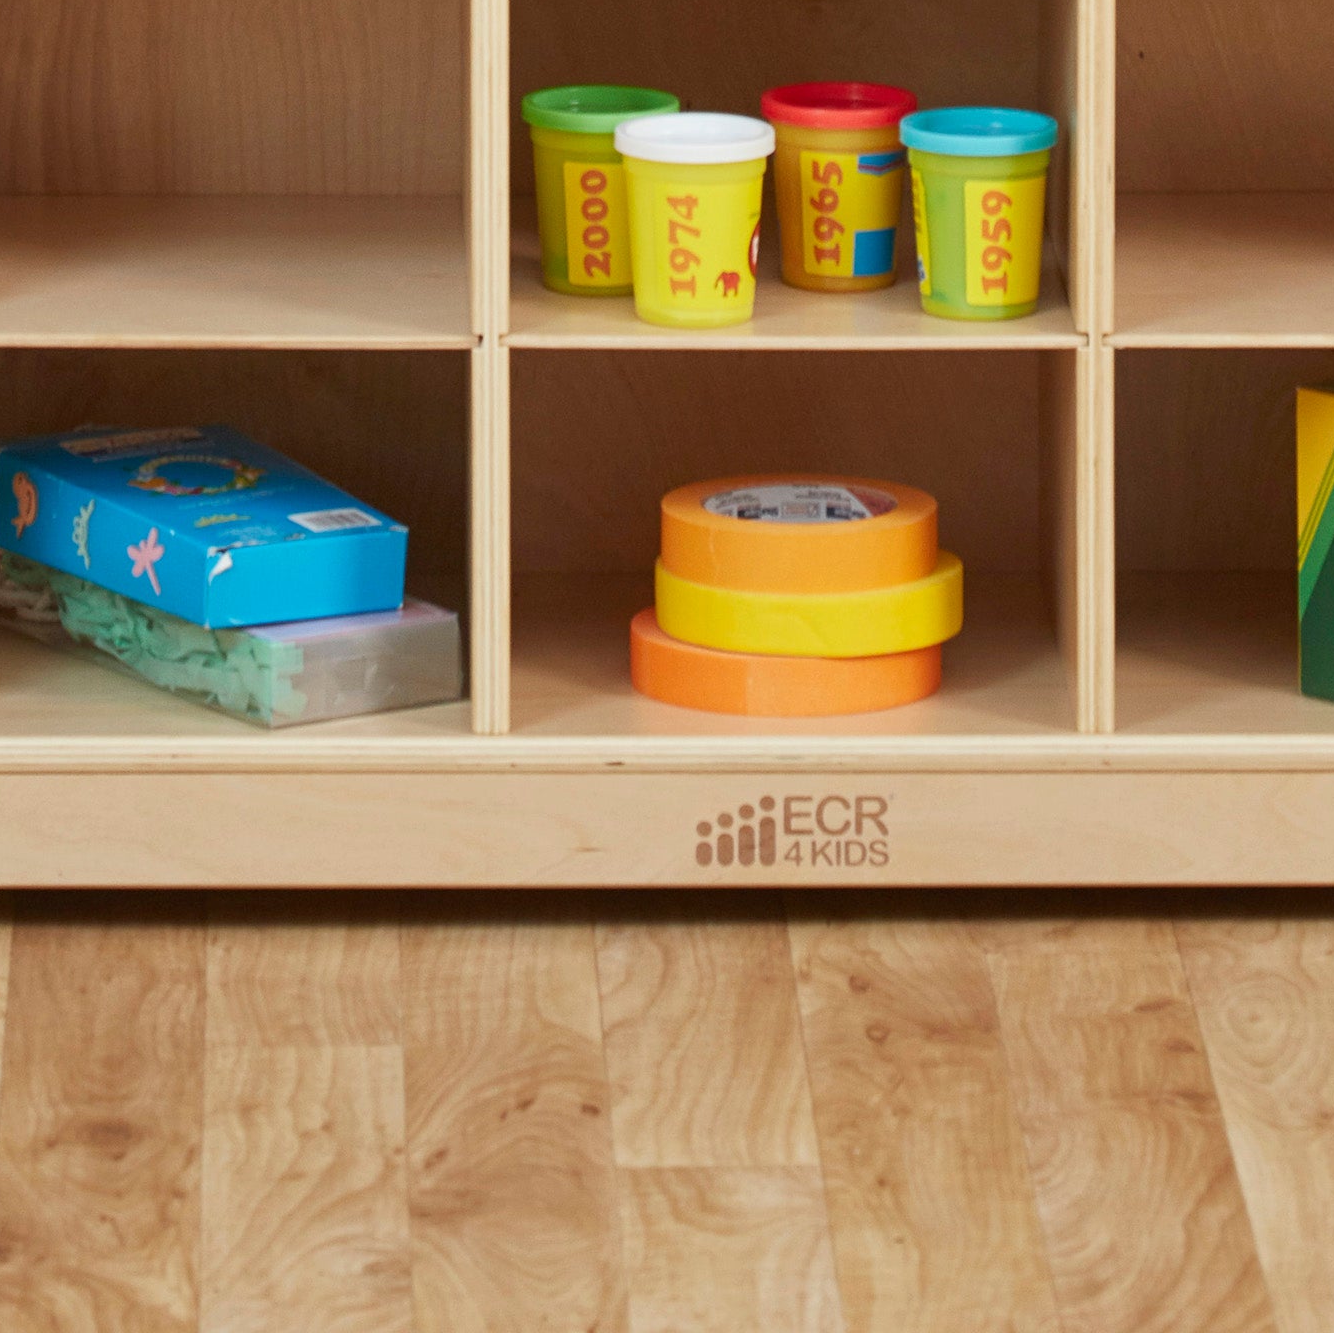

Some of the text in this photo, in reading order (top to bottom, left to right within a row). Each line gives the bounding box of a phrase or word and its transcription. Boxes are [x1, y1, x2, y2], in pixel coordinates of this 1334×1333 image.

[580, 169, 611, 278] 2000
[666, 194, 701, 299] 1974
[809, 160, 845, 267] 1965
[981, 190, 1013, 296] 1959
[782, 795, 889, 836] ECR
[783, 840, 890, 867] 4 KIDS
